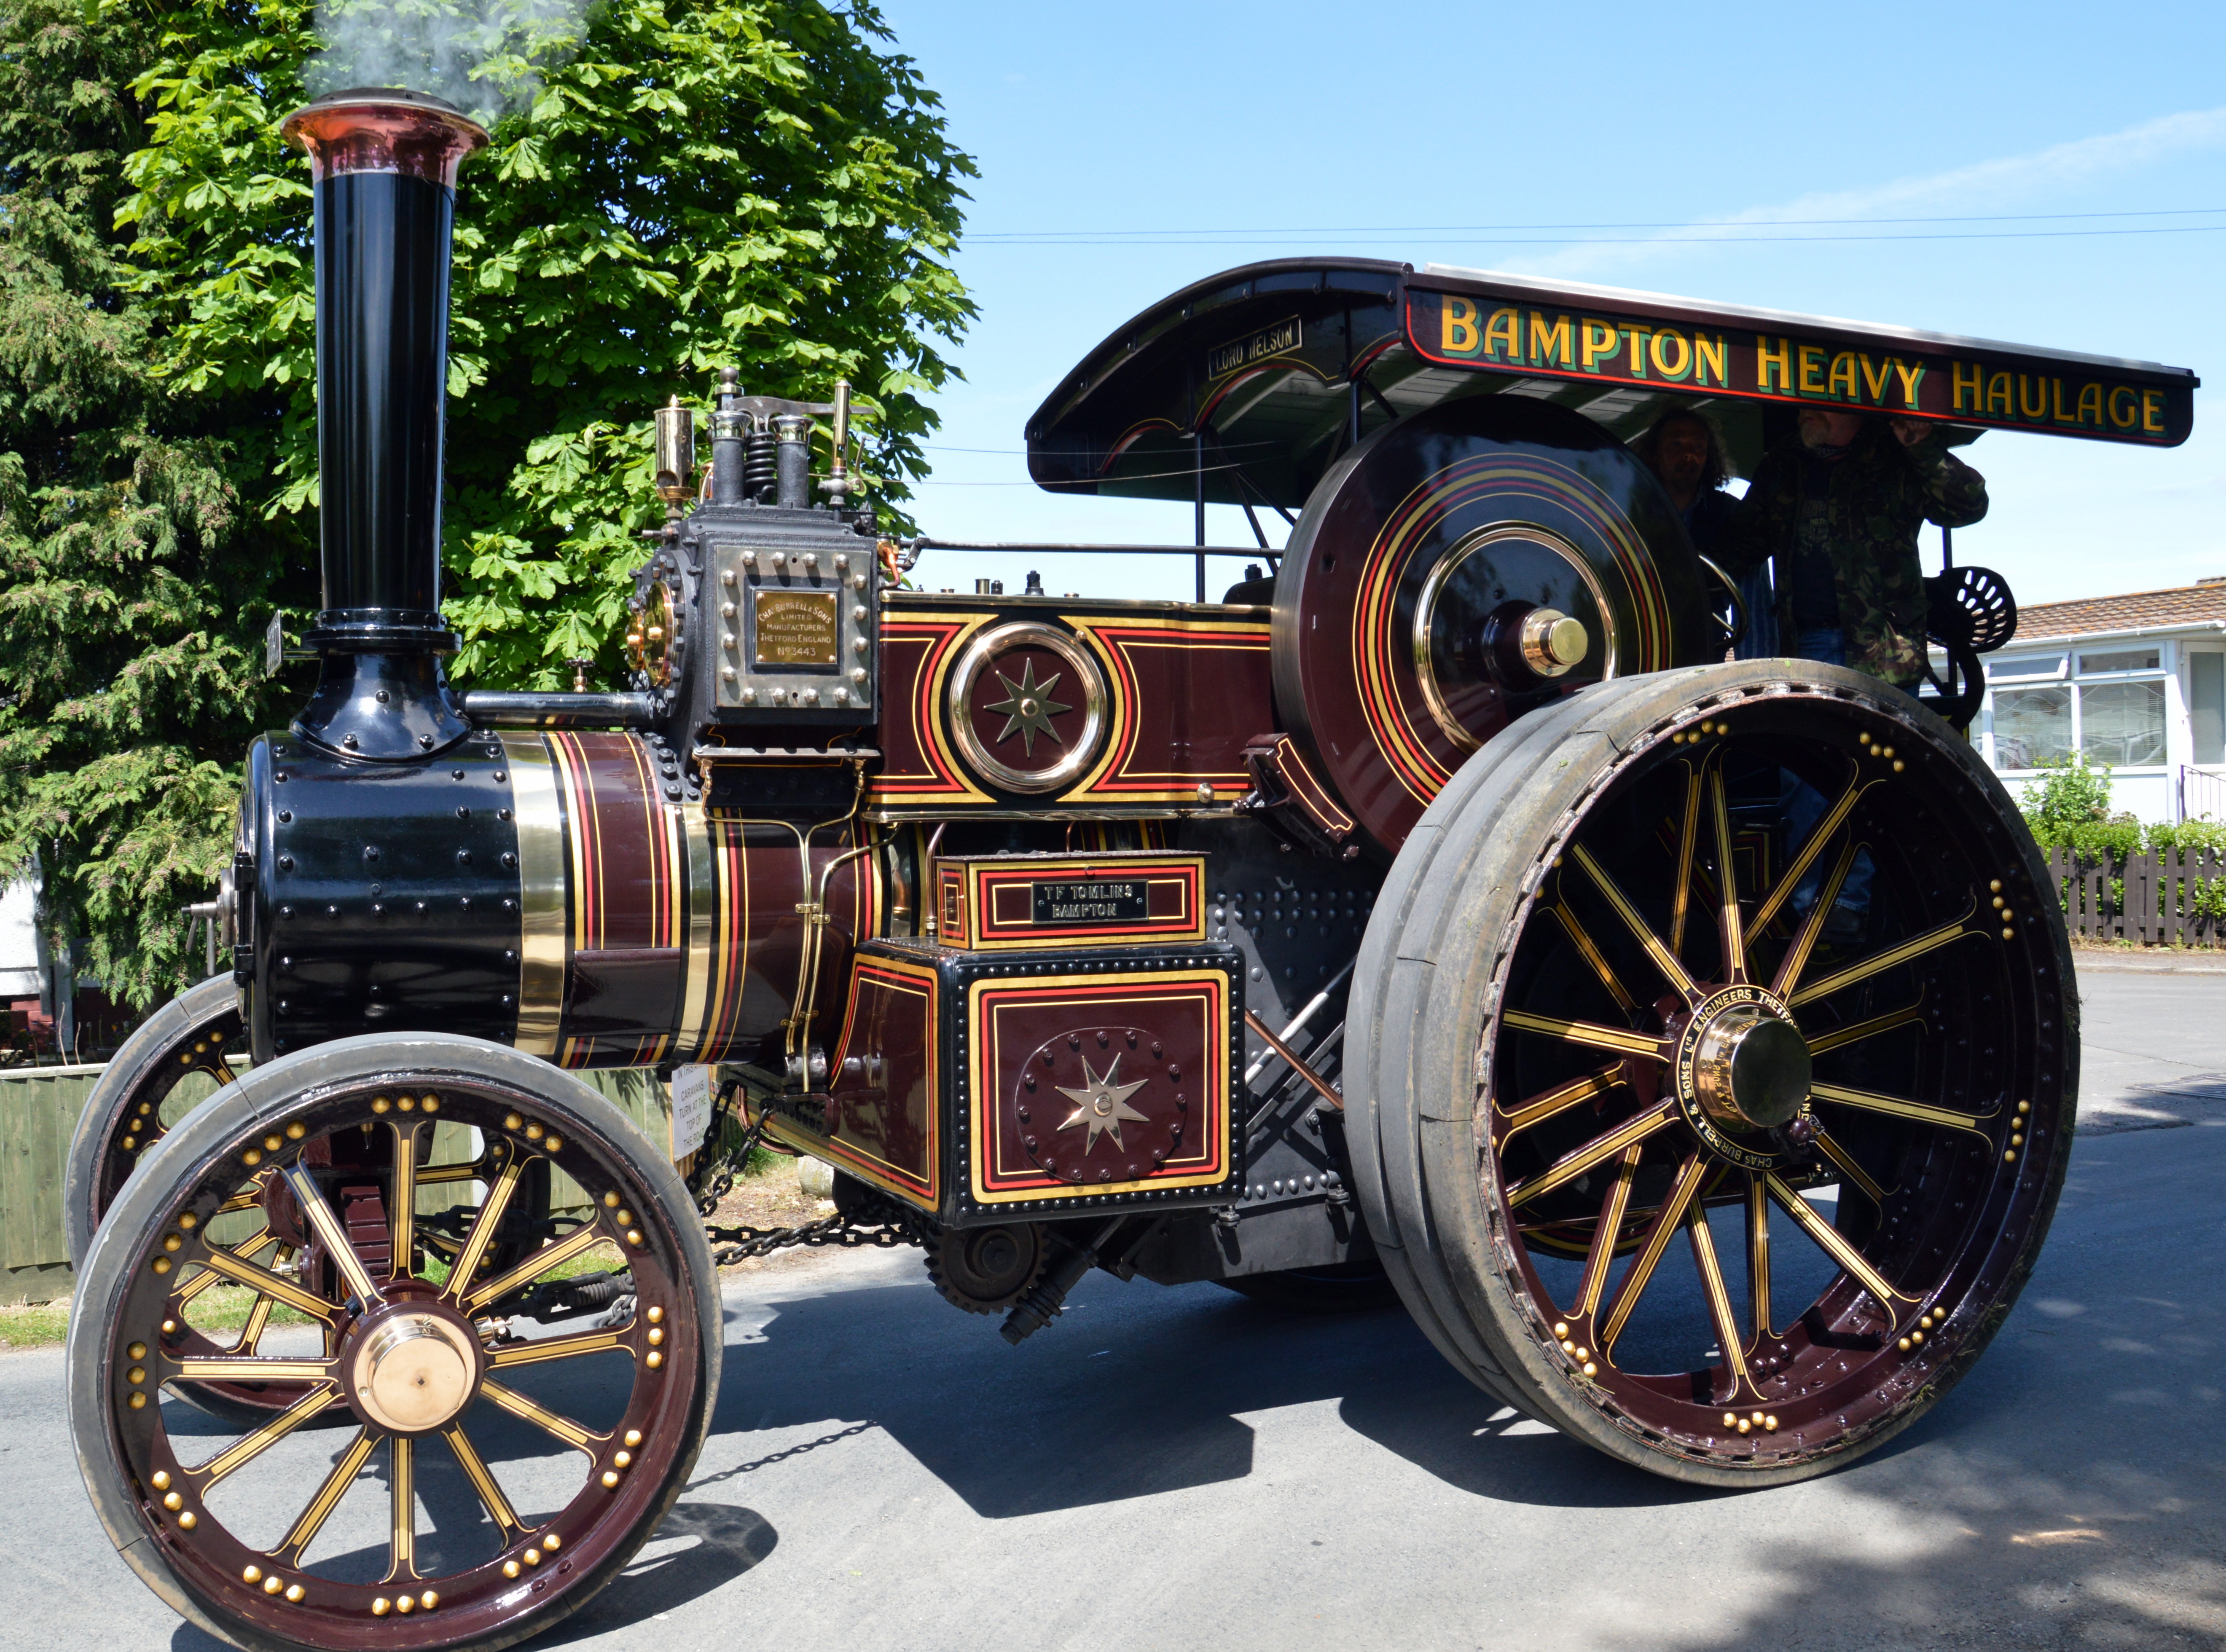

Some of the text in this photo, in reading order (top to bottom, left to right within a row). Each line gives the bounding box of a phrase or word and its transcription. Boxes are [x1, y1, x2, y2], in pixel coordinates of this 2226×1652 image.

[1216, 323, 1292, 371] LORD NELSON
[1442, 295, 2166, 434] BAMPTON HEAVY HAULAGE
[775, 602, 807, 612] BURRELL
[813, 607, 832, 624] SONS
[760, 633, 832, 644] THETFORD ENGLAND
[791, 647, 816, 656] 3443
[1044, 884, 1133, 900] T F TOMLINS
[1052, 903, 1117, 918] BAMPTON
[1693, 988, 1752, 1032] ENGINEERS
[1680, 1061, 1692, 1099] SONS
[681, 1080, 704, 1101] CARAVANS
[679, 1103, 691, 1119] TURN
[693, 1100, 698, 1113] AT
[1689, 1103, 1699, 1116] &
[686, 1113, 701, 1131] TOP OF
[683, 1135, 693, 1150] THE
[1698, 1116, 1743, 1161] BURRELL
[1745, 1155, 1772, 1168] CHAS
